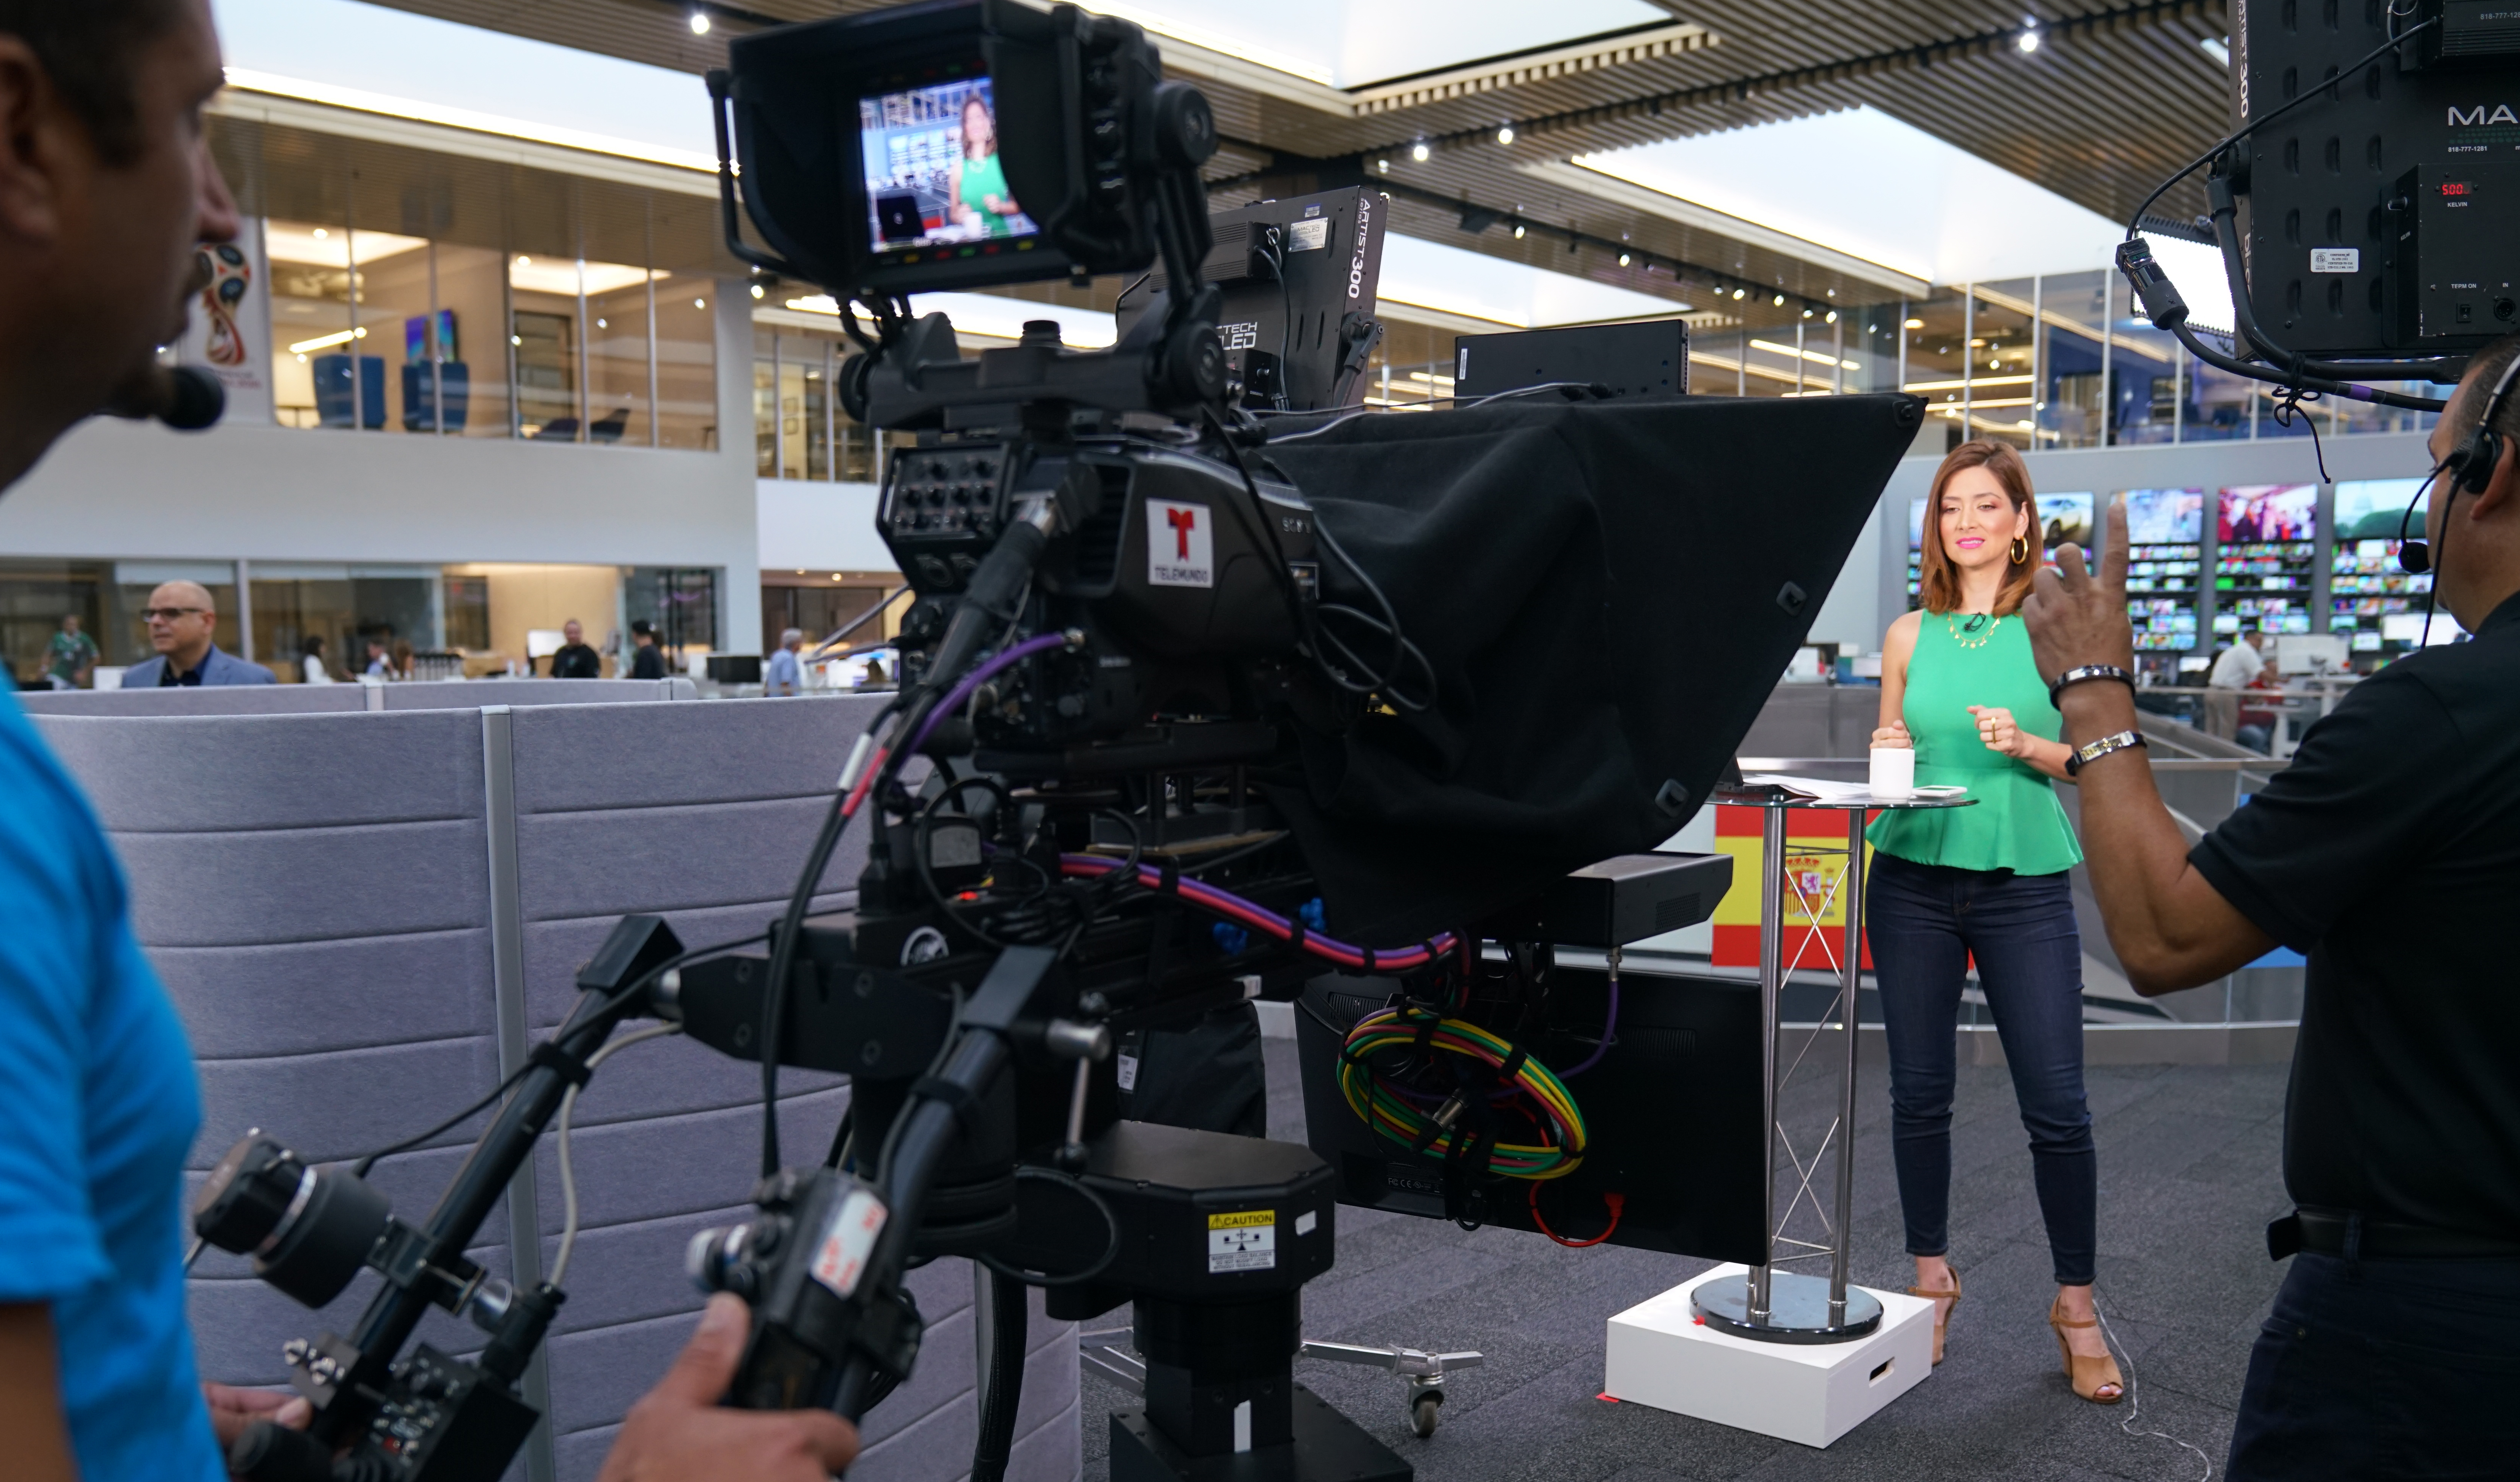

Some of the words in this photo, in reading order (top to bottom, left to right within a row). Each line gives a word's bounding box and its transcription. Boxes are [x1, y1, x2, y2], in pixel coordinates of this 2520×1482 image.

[1357, 199, 1370, 258] ARTIST
[2401, 231, 2410, 241] KELVIN
[1349, 256, 1363, 298] 300
[1216, 322, 1258, 334] TECH
[1222, 332, 1257, 350] LED
[1155, 567, 1209, 582] TELEMUNDO
[1223, 1214, 1272, 1226] CAUTION
